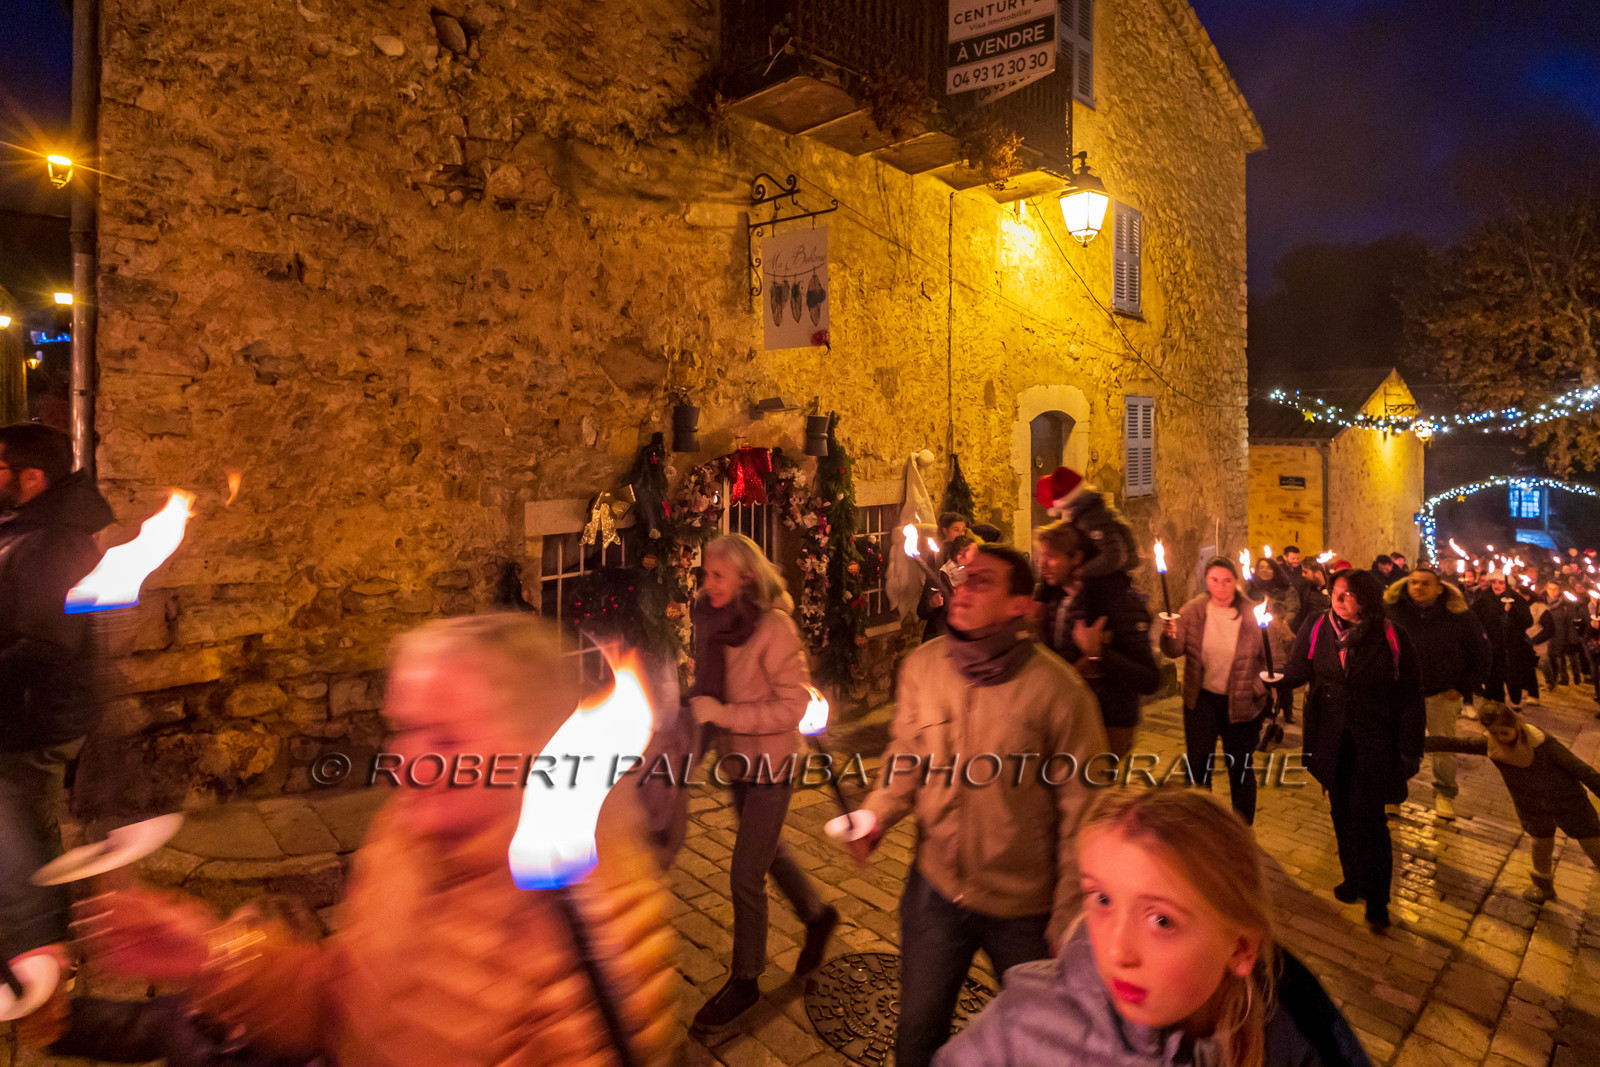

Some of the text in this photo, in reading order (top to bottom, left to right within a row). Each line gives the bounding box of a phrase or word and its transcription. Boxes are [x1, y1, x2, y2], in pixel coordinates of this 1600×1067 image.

[956, 23, 1045, 62] À VENDRE
[952, 71, 970, 88] 04
[972, 66, 989, 83] 93
[991, 62, 1005, 79] 12
[1007, 57, 1026, 75] 30
[1028, 51, 1048, 70] 30
